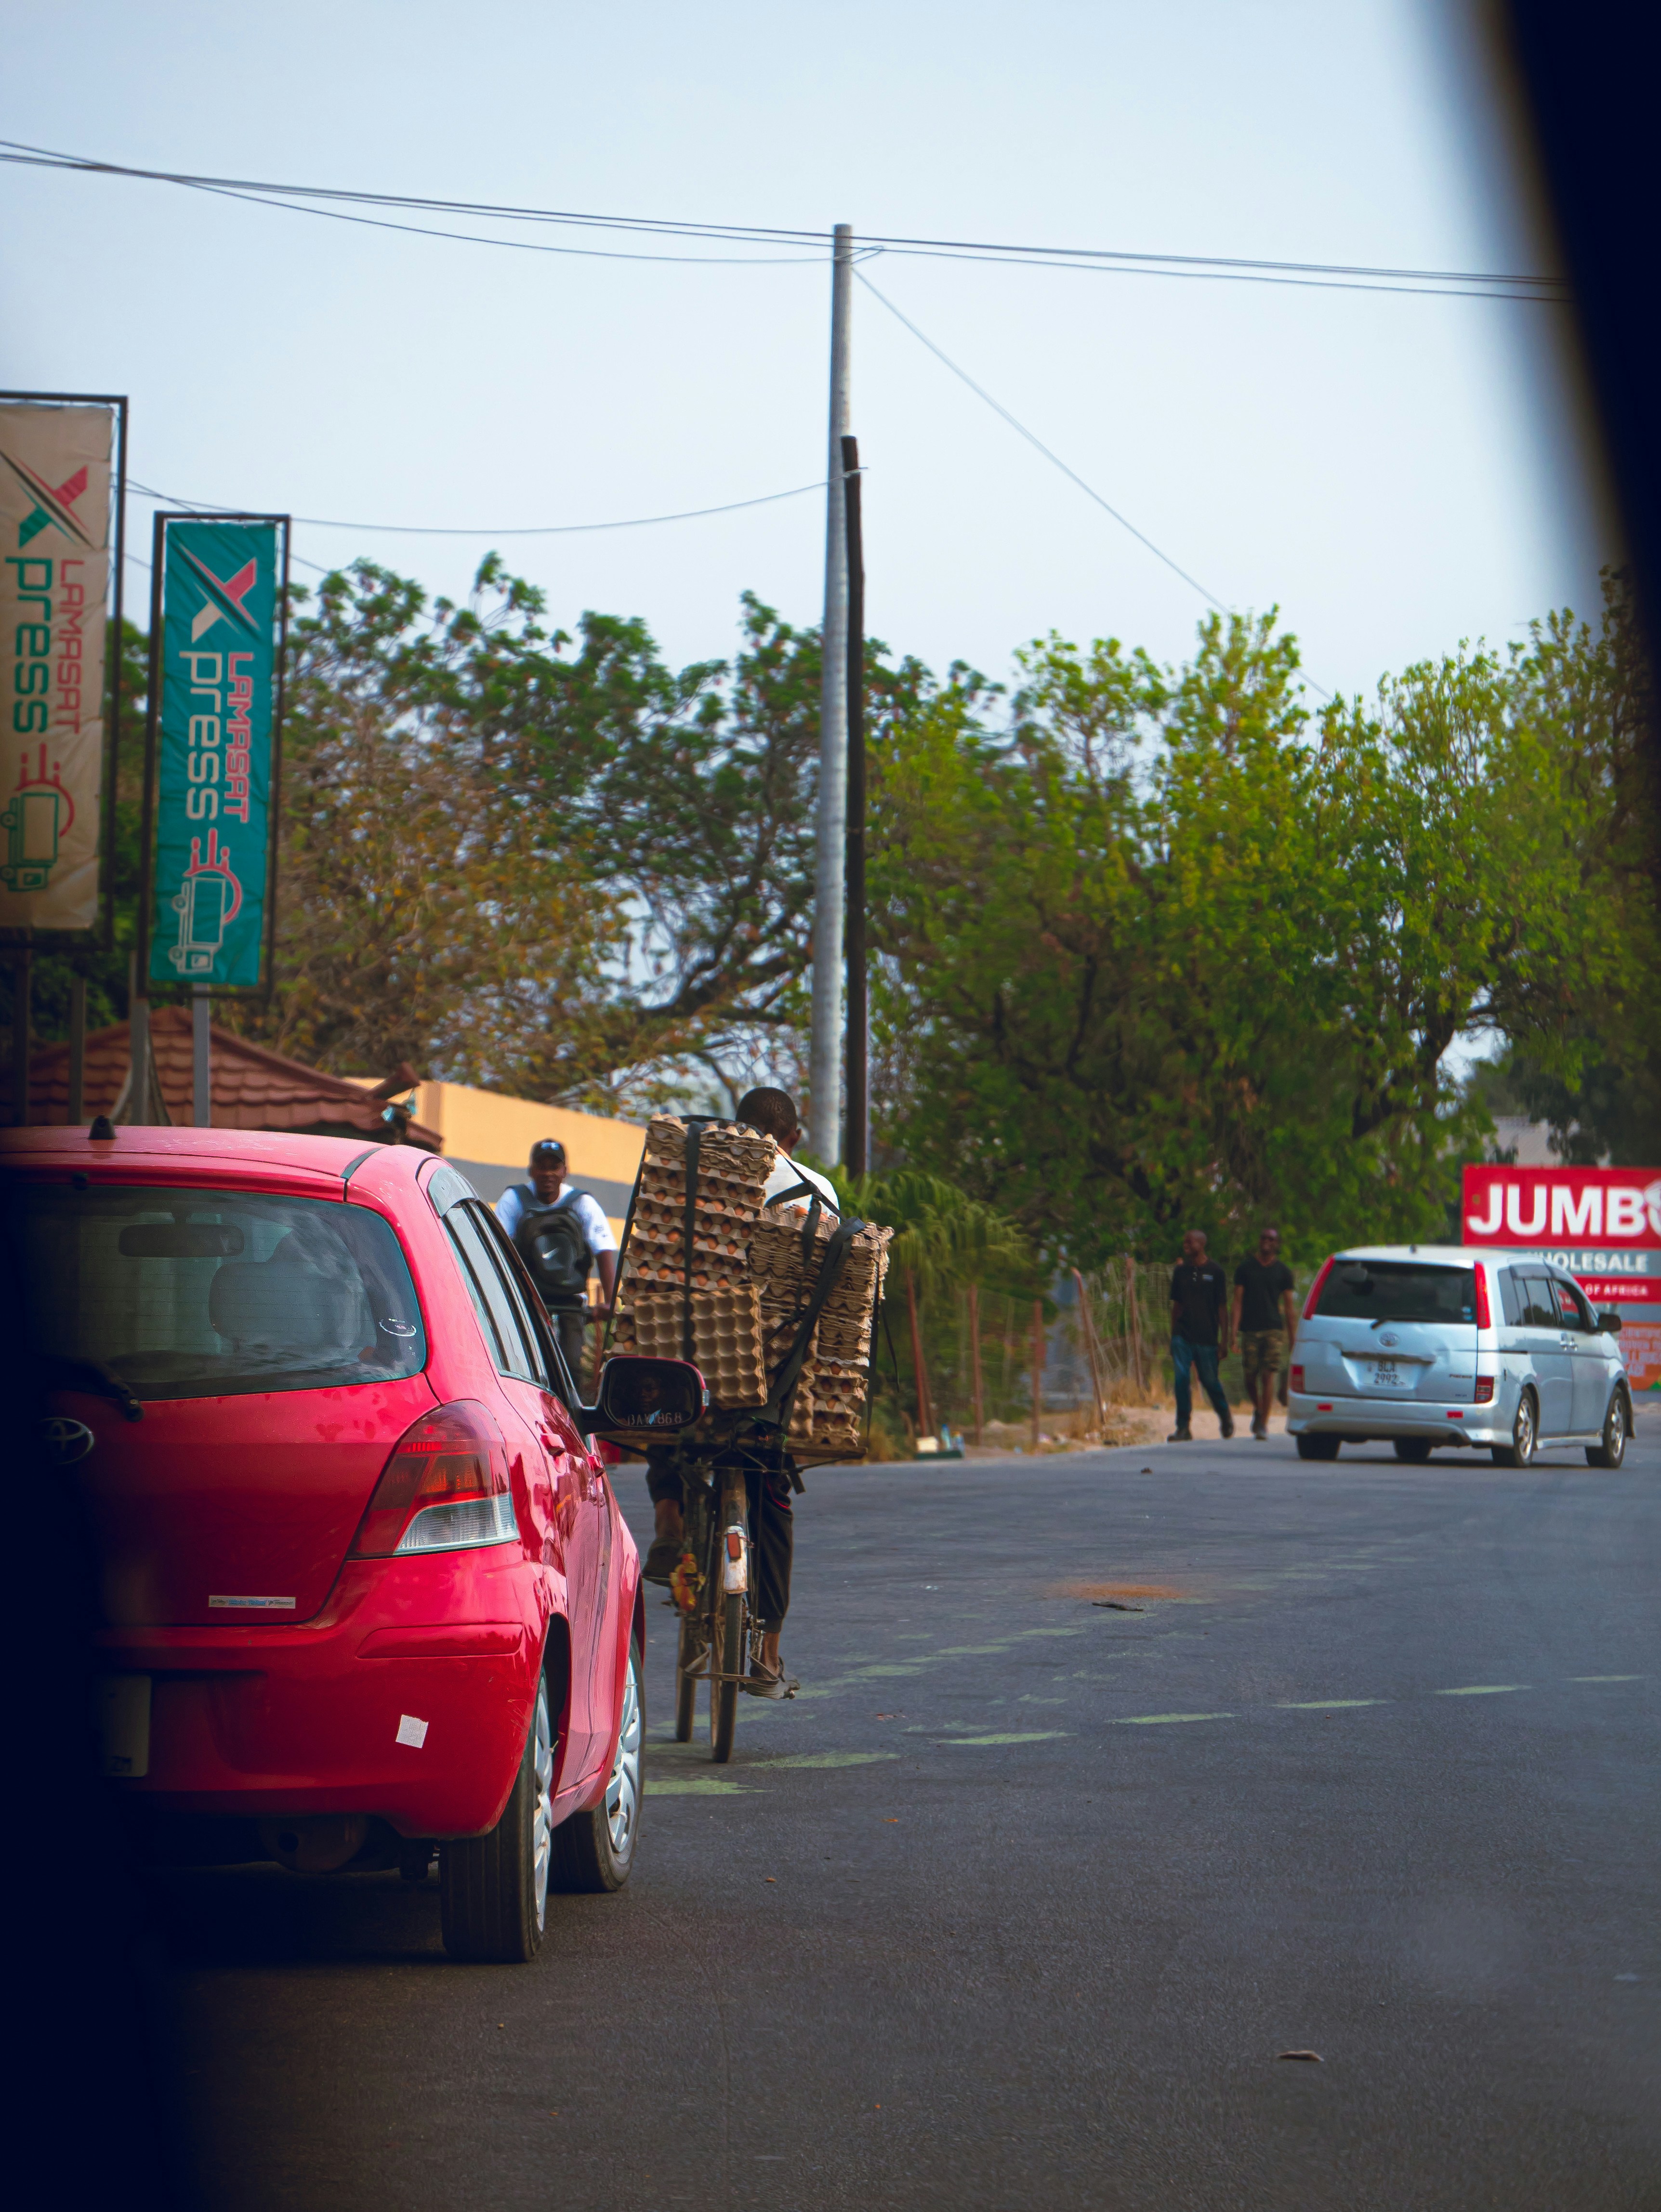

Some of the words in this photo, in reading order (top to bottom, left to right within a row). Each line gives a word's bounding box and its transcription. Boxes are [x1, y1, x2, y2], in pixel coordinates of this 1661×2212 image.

[55, 558, 85, 735] LAMASAT
[224, 651, 254, 823] LAMASAT
[1527, 1251, 1648, 1273] OLESALE
[1585, 1283, 1601, 1295] OF
[1374, 1372, 1397, 1385] 2992
